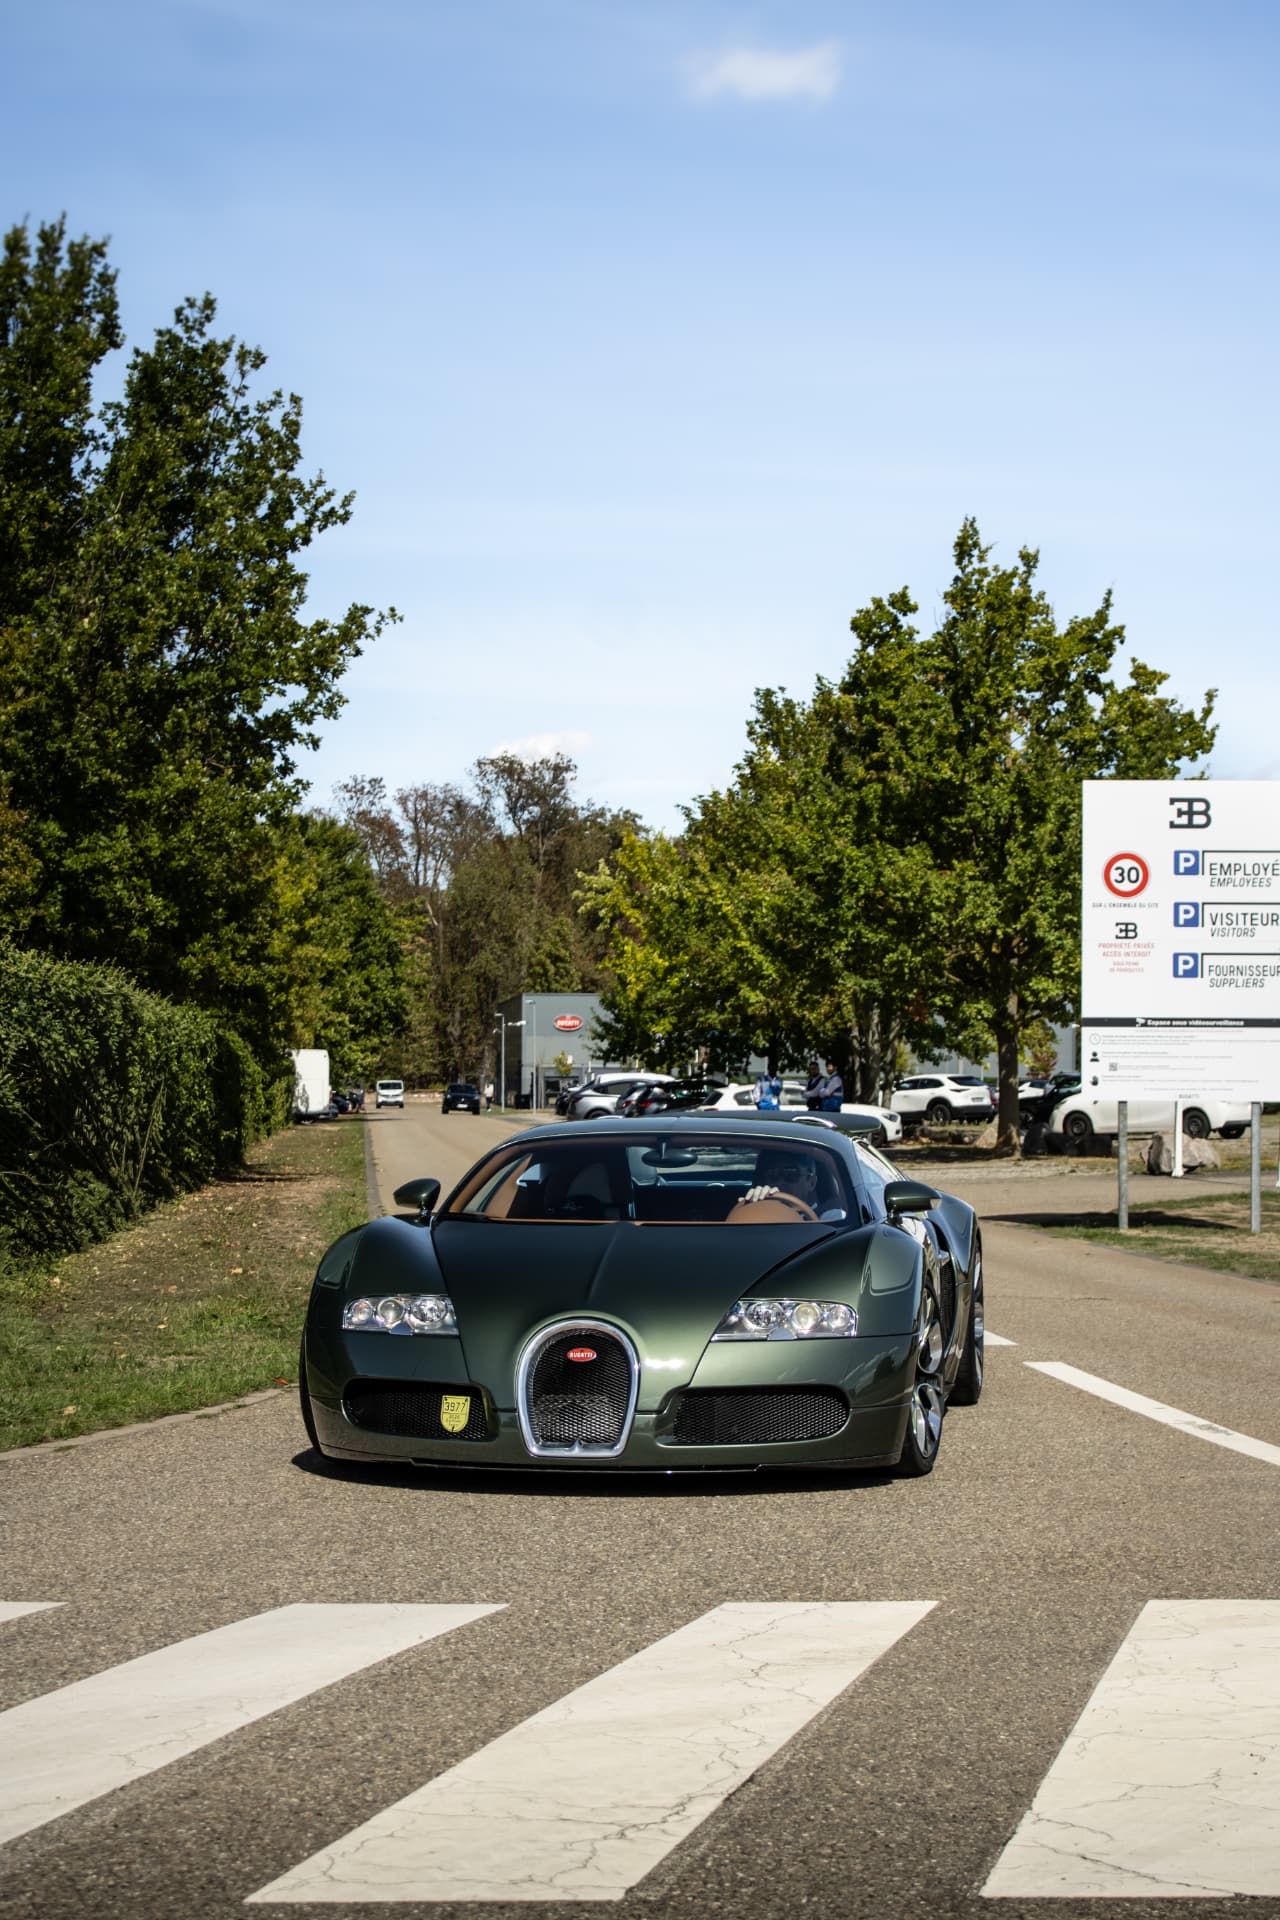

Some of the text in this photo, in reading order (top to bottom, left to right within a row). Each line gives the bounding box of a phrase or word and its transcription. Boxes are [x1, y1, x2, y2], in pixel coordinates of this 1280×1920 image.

[1178, 853, 1195, 873] P
[1114, 866, 1140, 884] 30
[1209, 877, 1272, 888] EMPLOYEES
[1178, 905, 1195, 925] P
[1209, 912, 1279, 927] VISITEUR
[1210, 927, 1256, 938] VISITORS
[1177, 955, 1195, 976] P
[1209, 977, 1265, 988] SUPPLIERS
[444, 1402, 466, 1412] 3977
